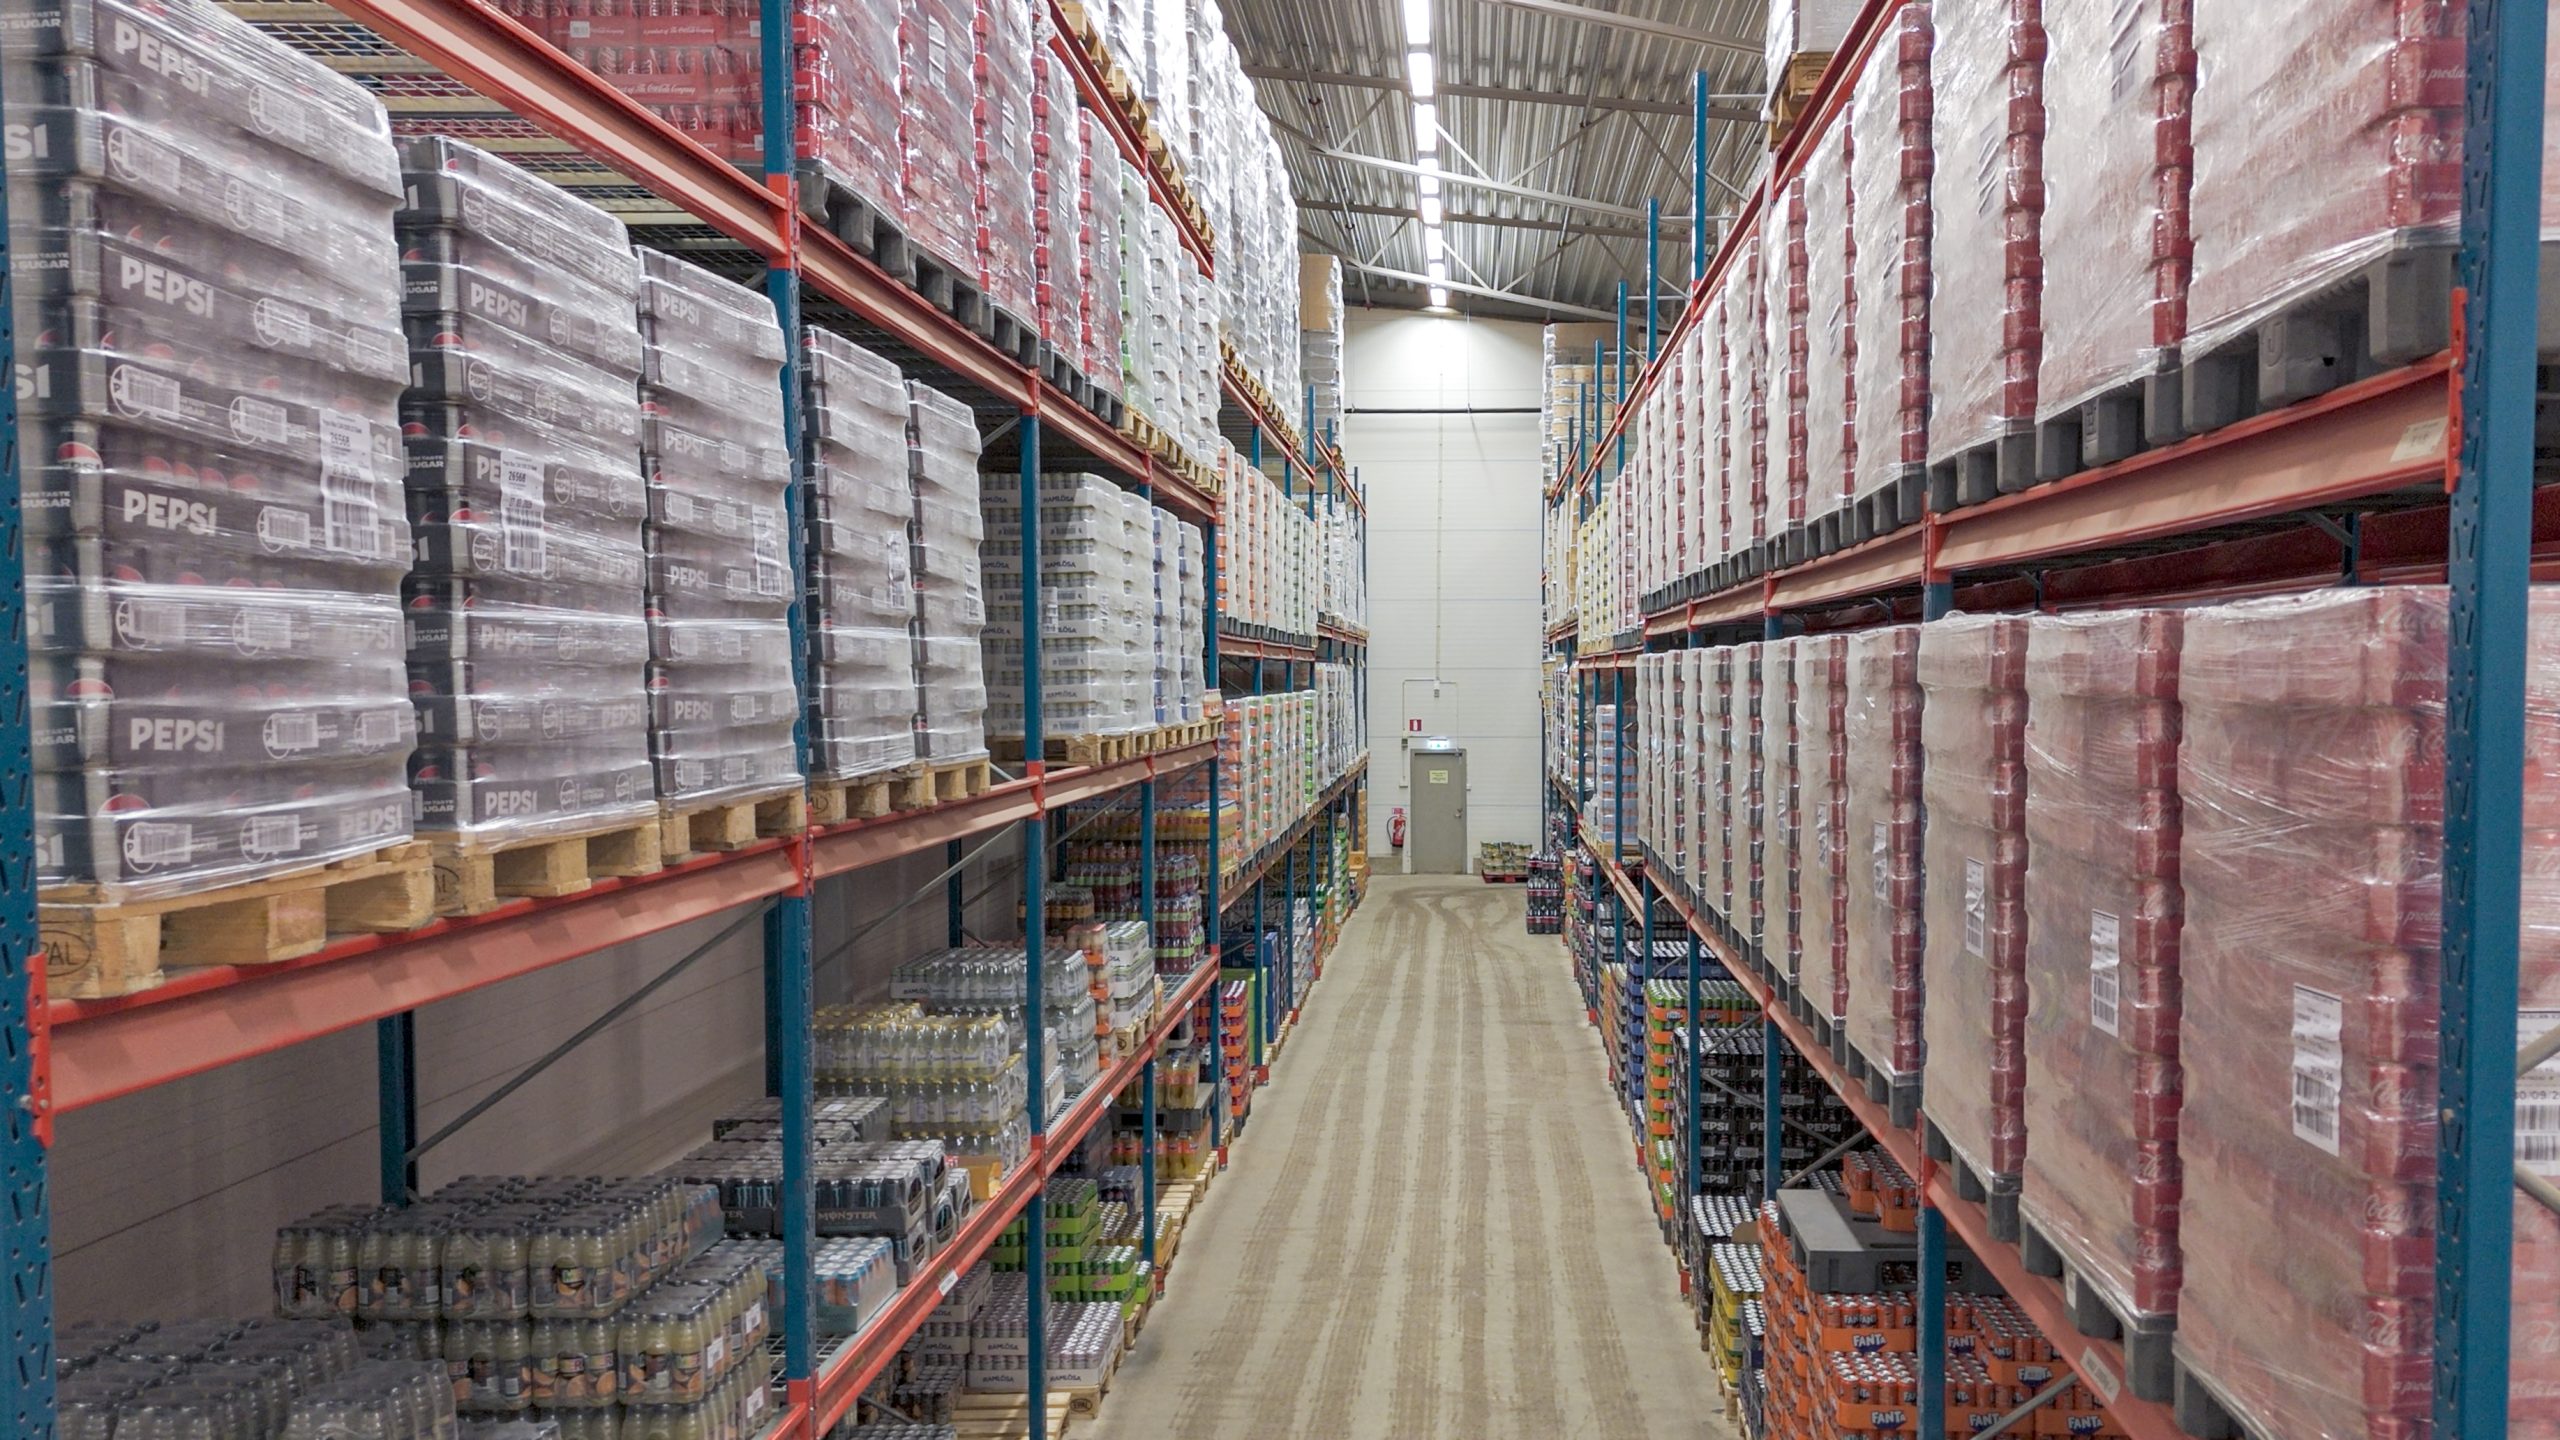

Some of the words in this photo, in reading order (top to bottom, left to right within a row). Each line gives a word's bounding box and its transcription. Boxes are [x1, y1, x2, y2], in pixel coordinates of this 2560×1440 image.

[11, 18, 61, 29] SUGAR
[115, 21, 210, 98] PEPSI
[18, 260, 70, 269] SUGAR
[121, 256, 215, 318] PEPSI
[407, 285, 438, 294] UGAR
[470, 282, 527, 328] PEPSI
[660, 291, 700, 327] PEPSI
[665, 430, 704, 459] PEPSI
[979, 496, 1008, 504] AMLÖSA
[124, 490, 217, 535] PEPSI
[981, 561, 1010, 570] AMLÖSA
[1044, 561, 1076, 570] RAMLÖSA
[670, 565, 709, 590] PEPSI
[416, 634, 448, 642] UGAR
[674, 700, 714, 720] PEPSI
[35, 735, 76, 745] UGAR
[130, 719, 224, 752] PEPSI
[485, 790, 538, 815] PEPSI
[44, 942, 75, 966] PAL
[1701, 1068, 1730, 1078] EPSI
[1701, 1121, 1729, 1131] EPSI
[1806, 1123, 1841, 1132] PEPSI
[1701, 1174, 1729, 1184] EPSI
[817, 1210, 878, 1221] MONSTER
[926, 1342, 953, 1351] AMLÖSA
[1853, 1333, 1886, 1347] FANTA
[1947, 1335, 1977, 1348] FANT
[1871, 1410, 1906, 1424] FANTA
[1969, 1413, 2000, 1427] FANT
[2068, 1415, 2103, 1429] FANTA
